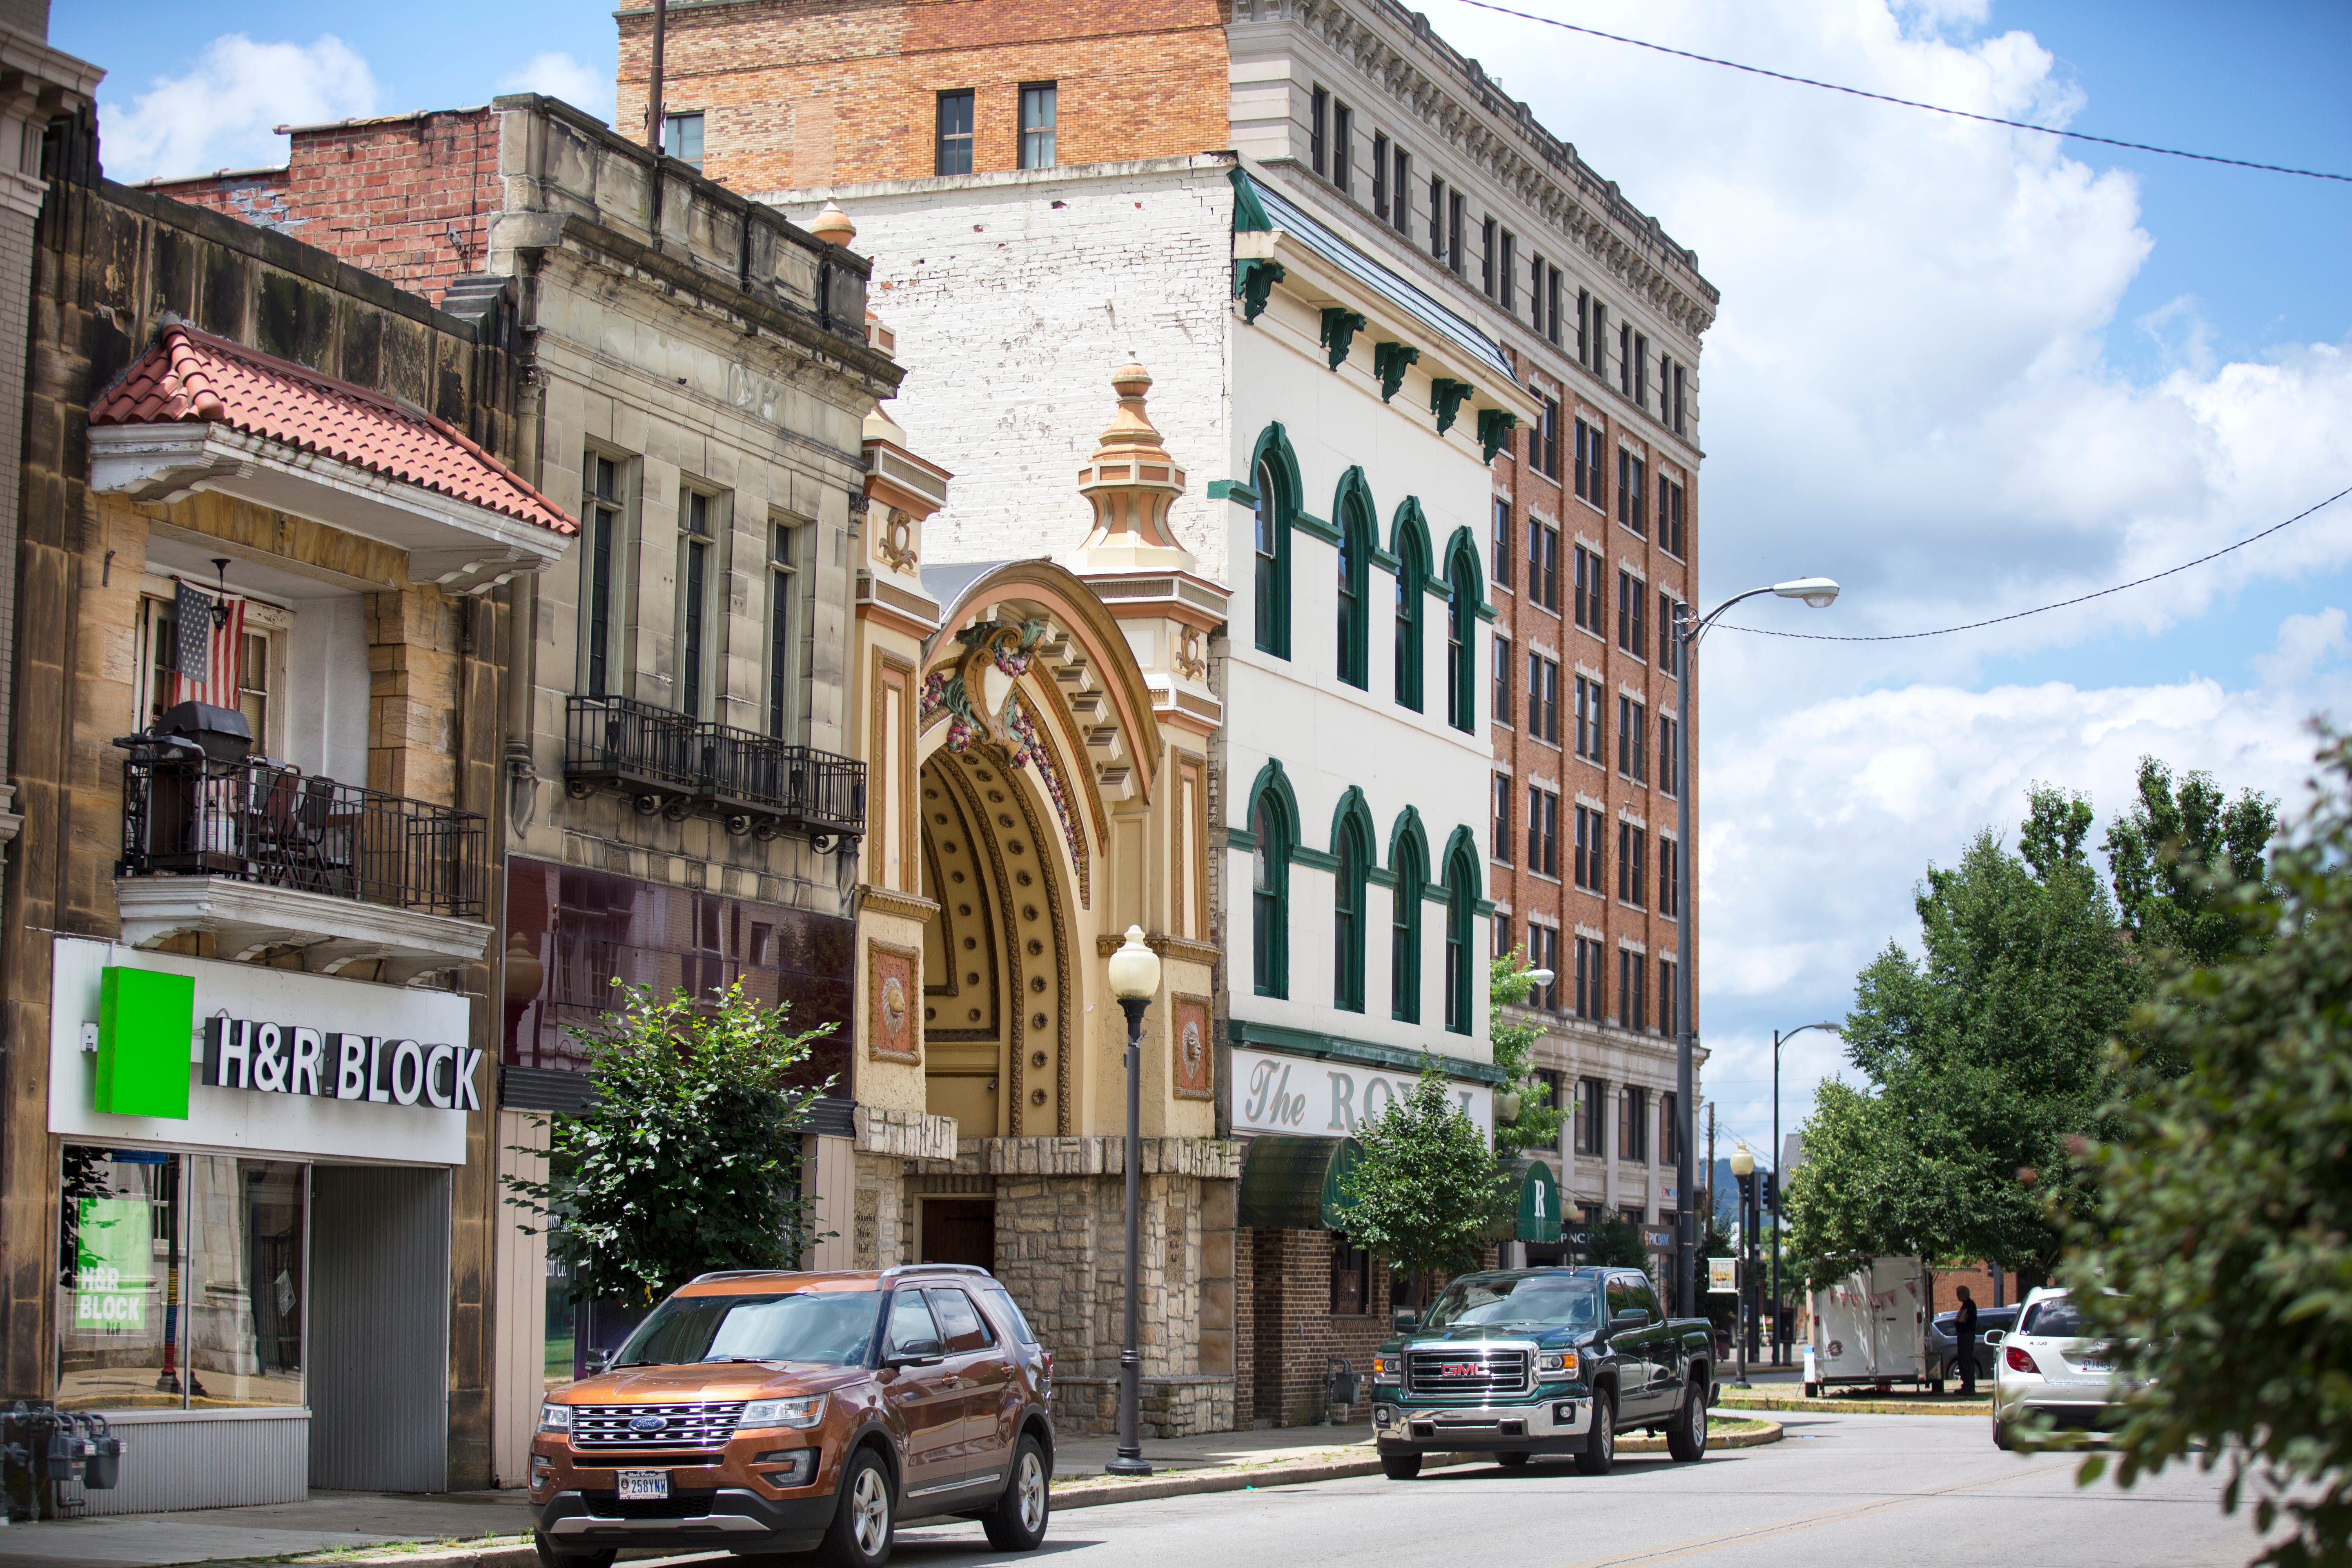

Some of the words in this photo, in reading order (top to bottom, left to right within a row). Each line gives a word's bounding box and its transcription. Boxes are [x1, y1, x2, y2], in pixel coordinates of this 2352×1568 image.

[215, 1017, 320, 1096] H&R
[335, 1033, 484, 1111] BLOCK
[1245, 1059, 1305, 1127] The
[1327, 1070, 1473, 1137] ROY
[1535, 1179, 1545, 1217] R
[1166, 1227, 1183, 1236] Columbia
[858, 1243, 869, 1253] Hall
[1169, 1241, 1179, 1249] Music
[546, 1254, 556, 1277] air
[1170, 1254, 1178, 1263] Hall
[81, 1266, 120, 1292] H&R
[80, 1294, 140, 1321] BLOCK
[636, 1417, 658, 1428] Ford
[631, 1479, 666, 1493] 258YNW
